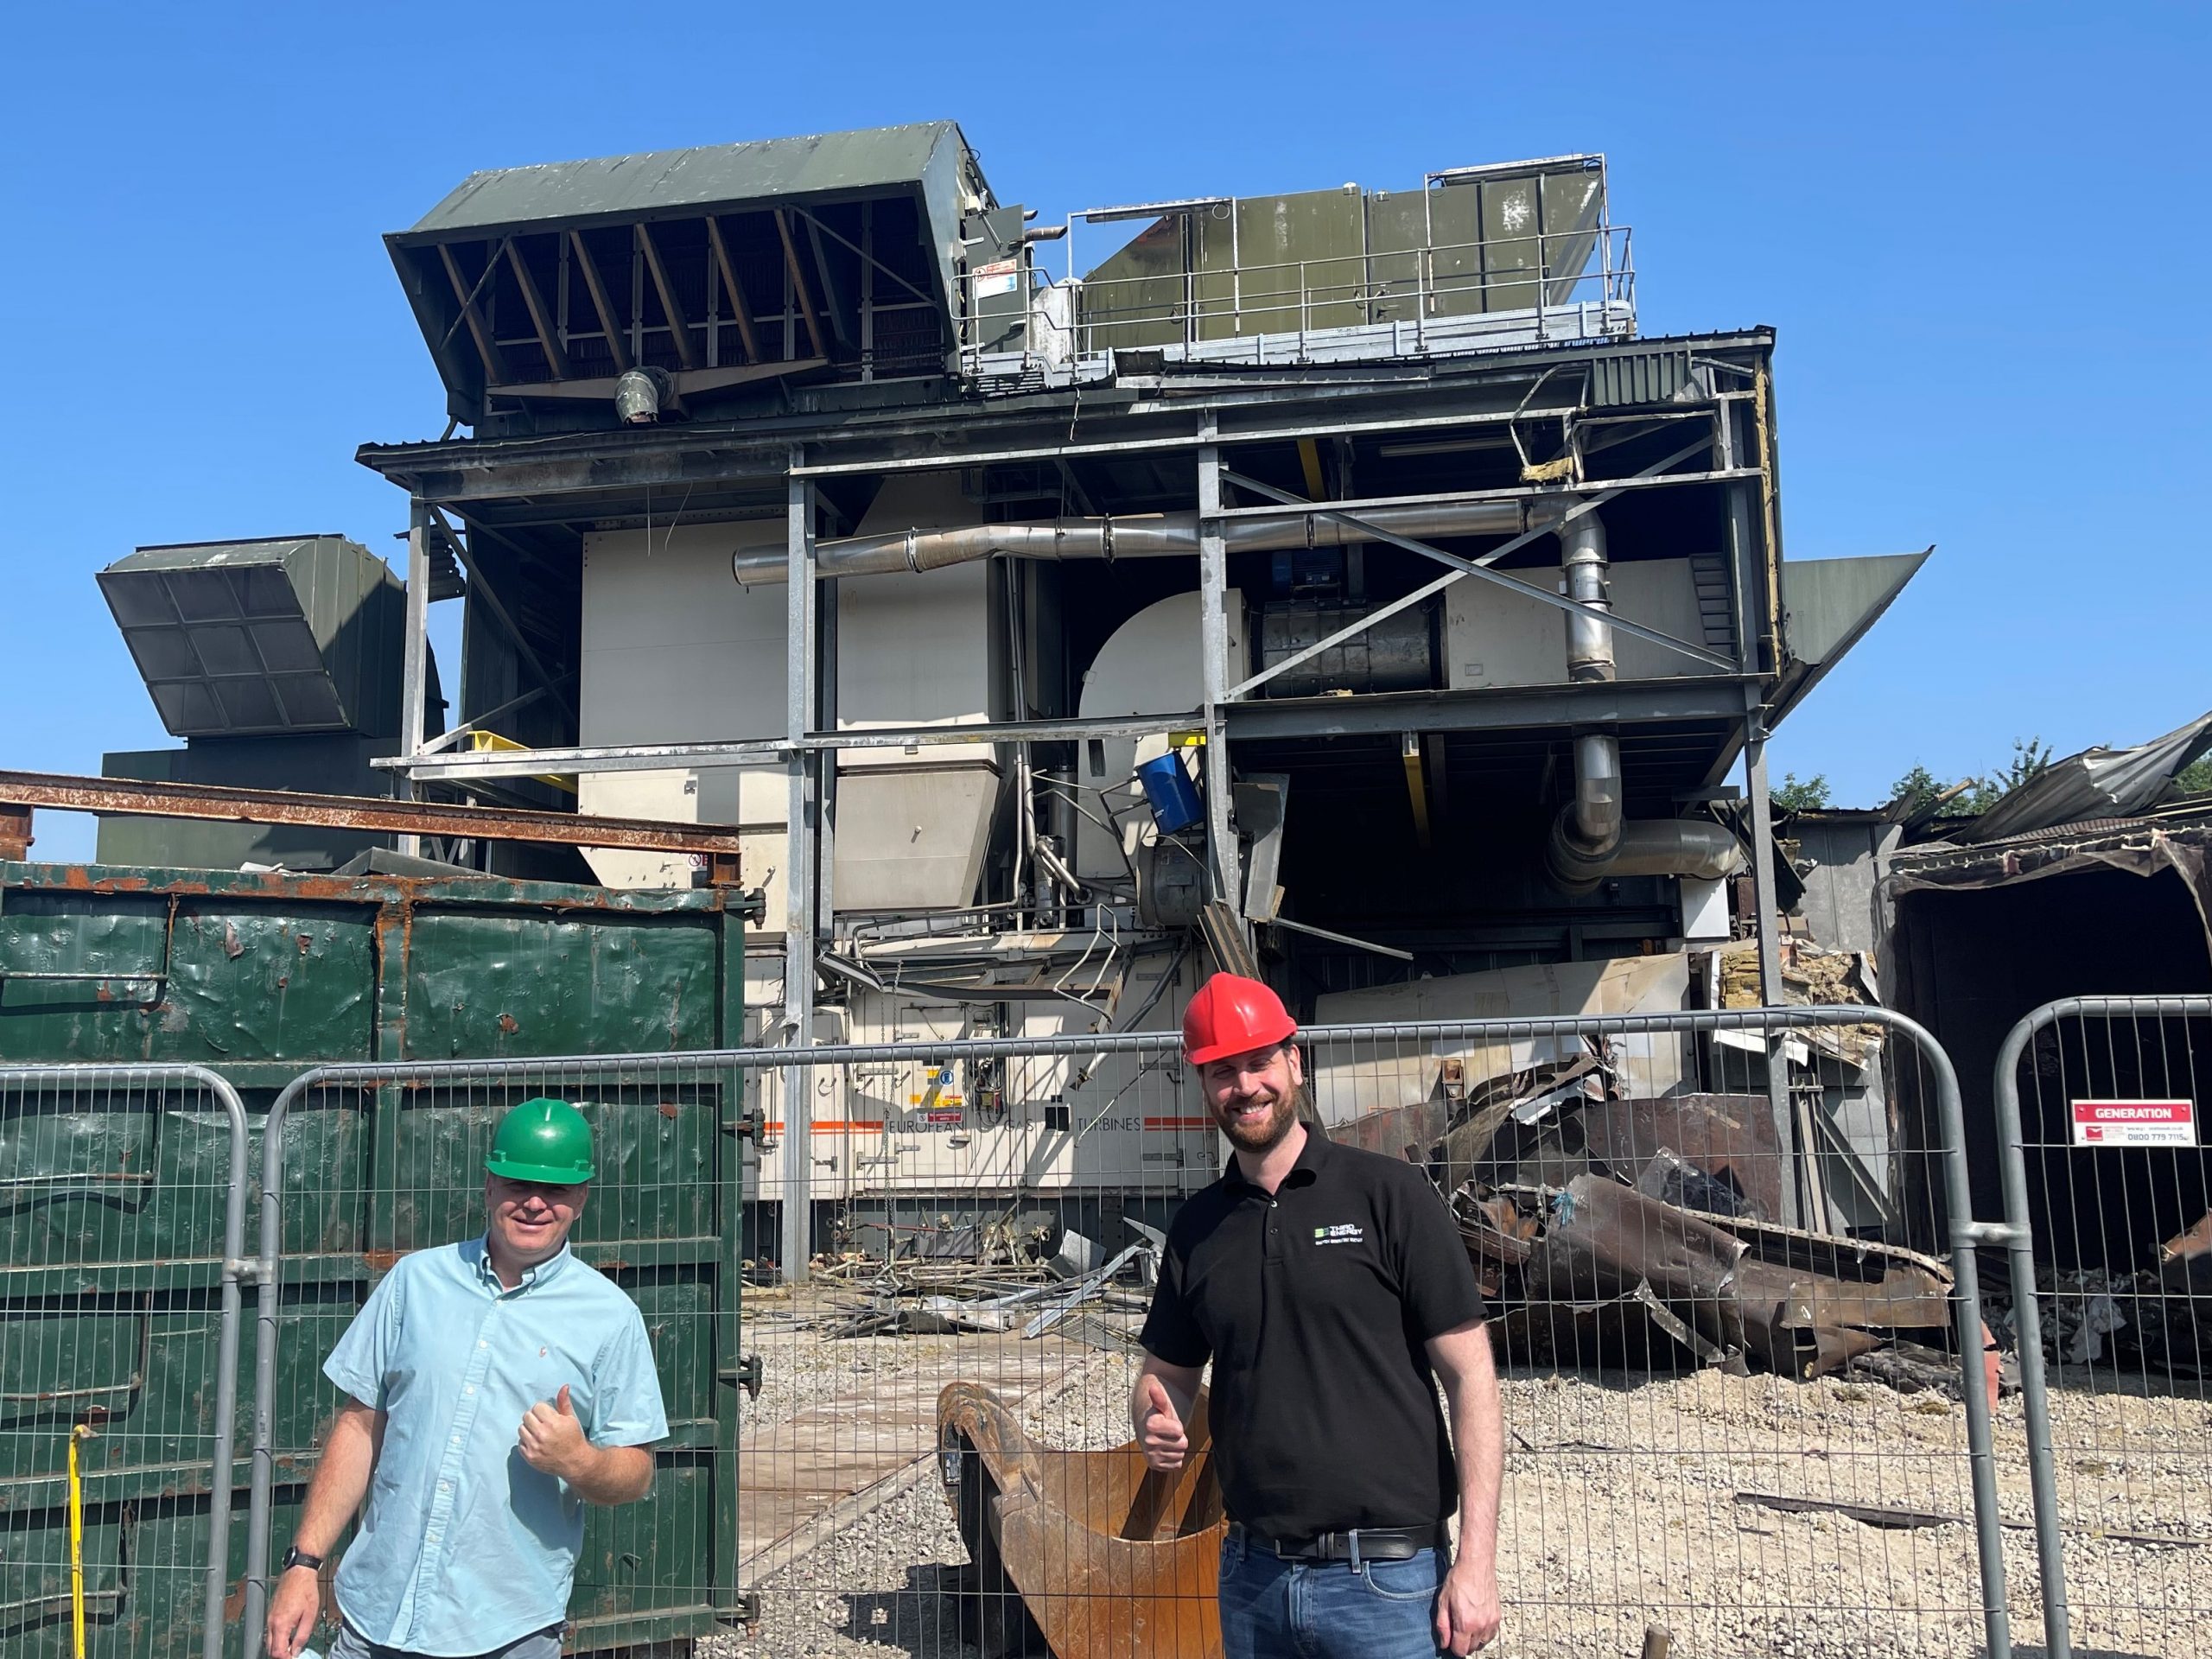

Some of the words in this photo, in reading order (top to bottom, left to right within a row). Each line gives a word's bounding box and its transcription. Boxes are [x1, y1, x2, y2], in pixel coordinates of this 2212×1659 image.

[2095, 1108, 2172, 1119] GENERATION
[889, 1121, 964, 1133] EUROPEAN
[1004, 1119, 1034, 1132] GAS
[1077, 1117, 1141, 1131] TURBINES
[1330, 1228, 1363, 1236] ENERGY
